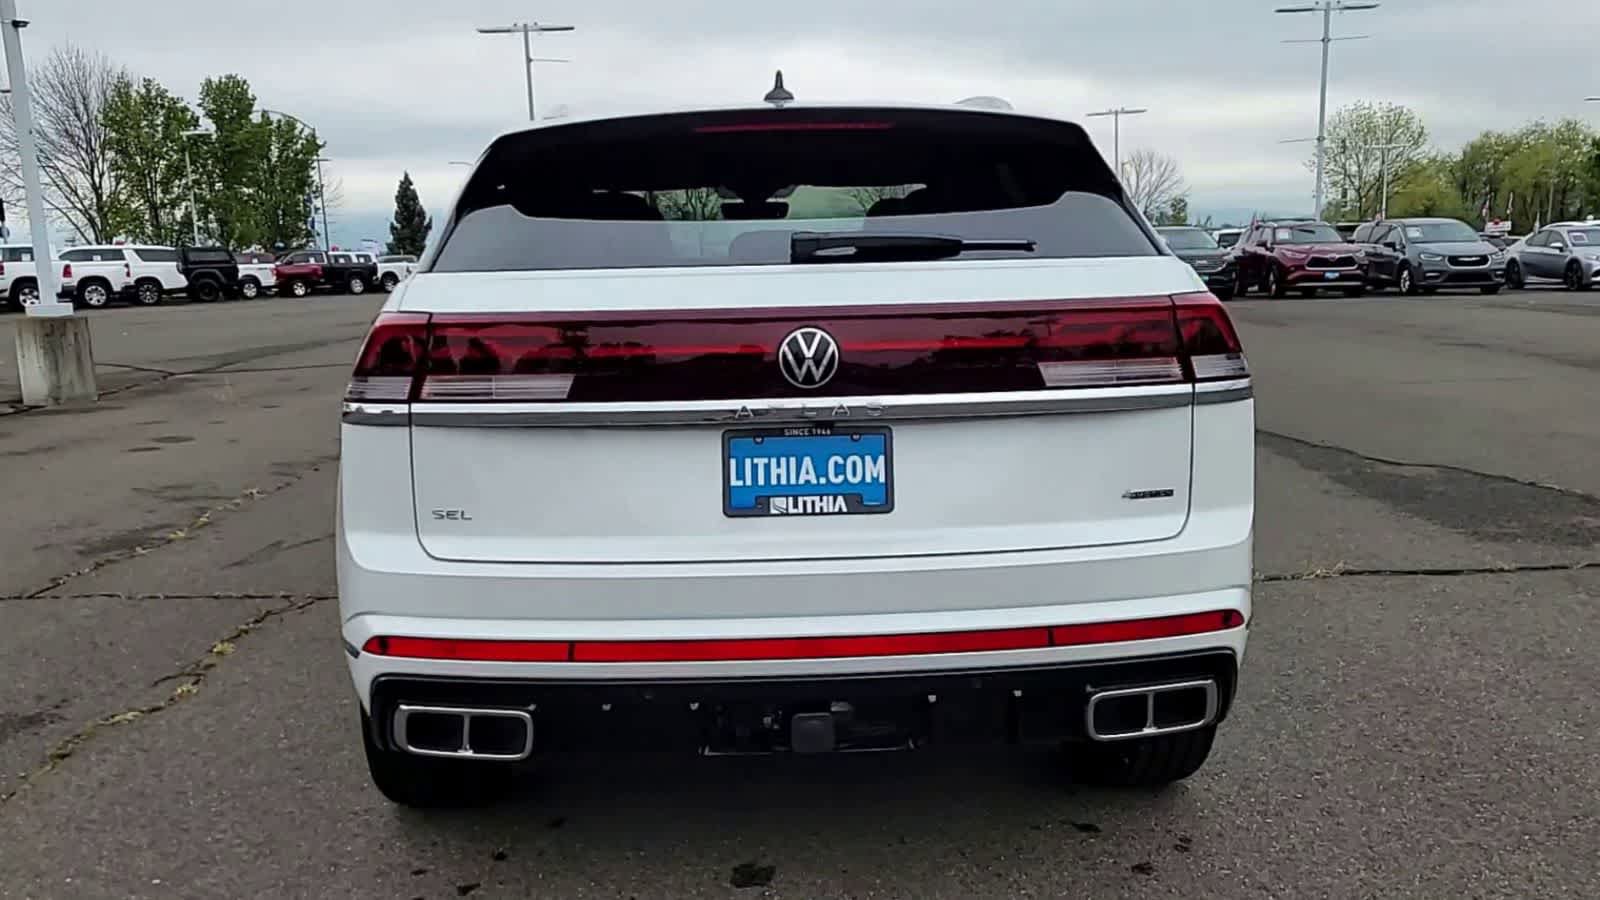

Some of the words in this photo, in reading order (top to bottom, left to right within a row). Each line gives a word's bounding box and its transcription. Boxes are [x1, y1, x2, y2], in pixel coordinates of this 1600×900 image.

[729, 454, 886, 487] LITHIA.COM
[787, 495, 848, 514] LITHIA
[431, 510, 473, 520] SEL
